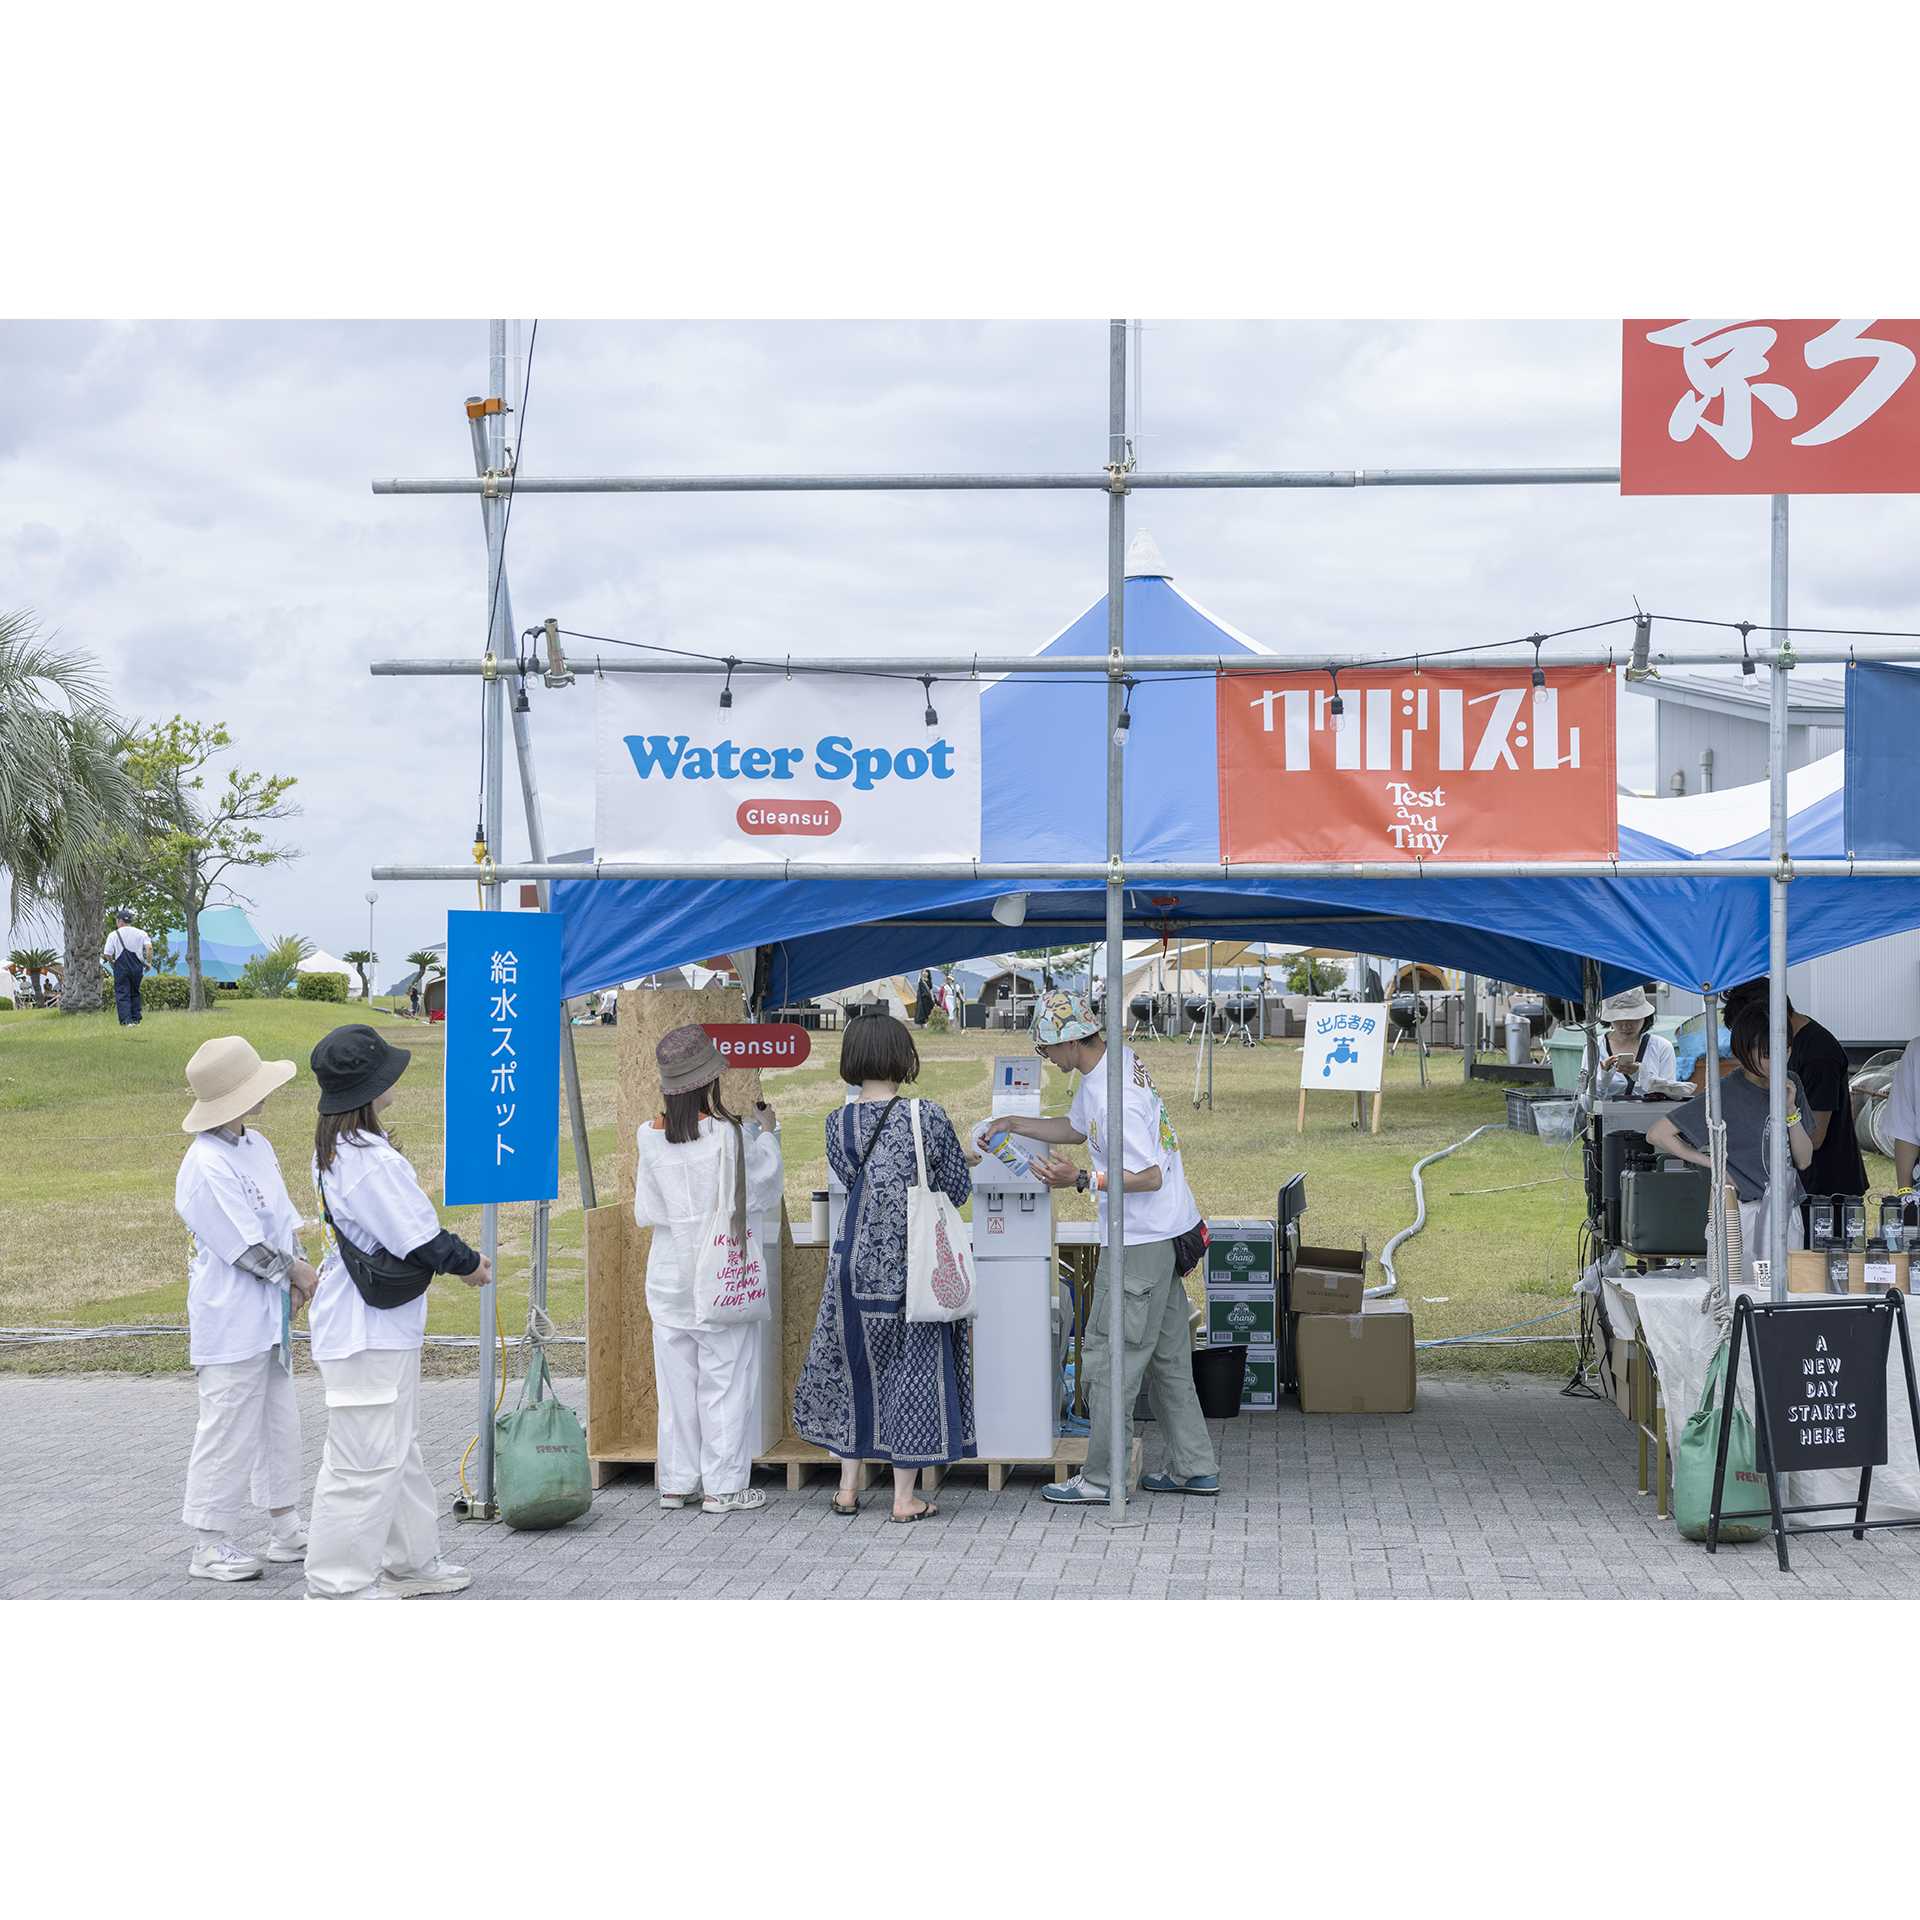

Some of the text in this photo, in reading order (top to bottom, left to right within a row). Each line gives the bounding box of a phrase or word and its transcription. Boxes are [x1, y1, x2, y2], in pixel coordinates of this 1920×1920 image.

[623, 735, 955, 791] Water Spot
[1386, 782, 1446, 807] Test
[746, 808, 830, 826] Cleansui
[1396, 806, 1438, 832] and
[1386, 824, 1449, 855] Tiny
[1316, 1014, 1376, 1036] 出店者用
[712, 1035, 796, 1055] leansui
[490, 950, 518, 1166] 給水スポット
[1226, 1251, 1255, 1264] Chang
[720, 1294, 746, 1307] LOVE
[1228, 1311, 1255, 1323] Chang
[1816, 1335, 1828, 1352] A
[1802, 1357, 1842, 1375] NEW
[1806, 1380, 1838, 1398] DAY
[1788, 1403, 1857, 1423] STARTS
[1800, 1426, 1846, 1445] HERE
